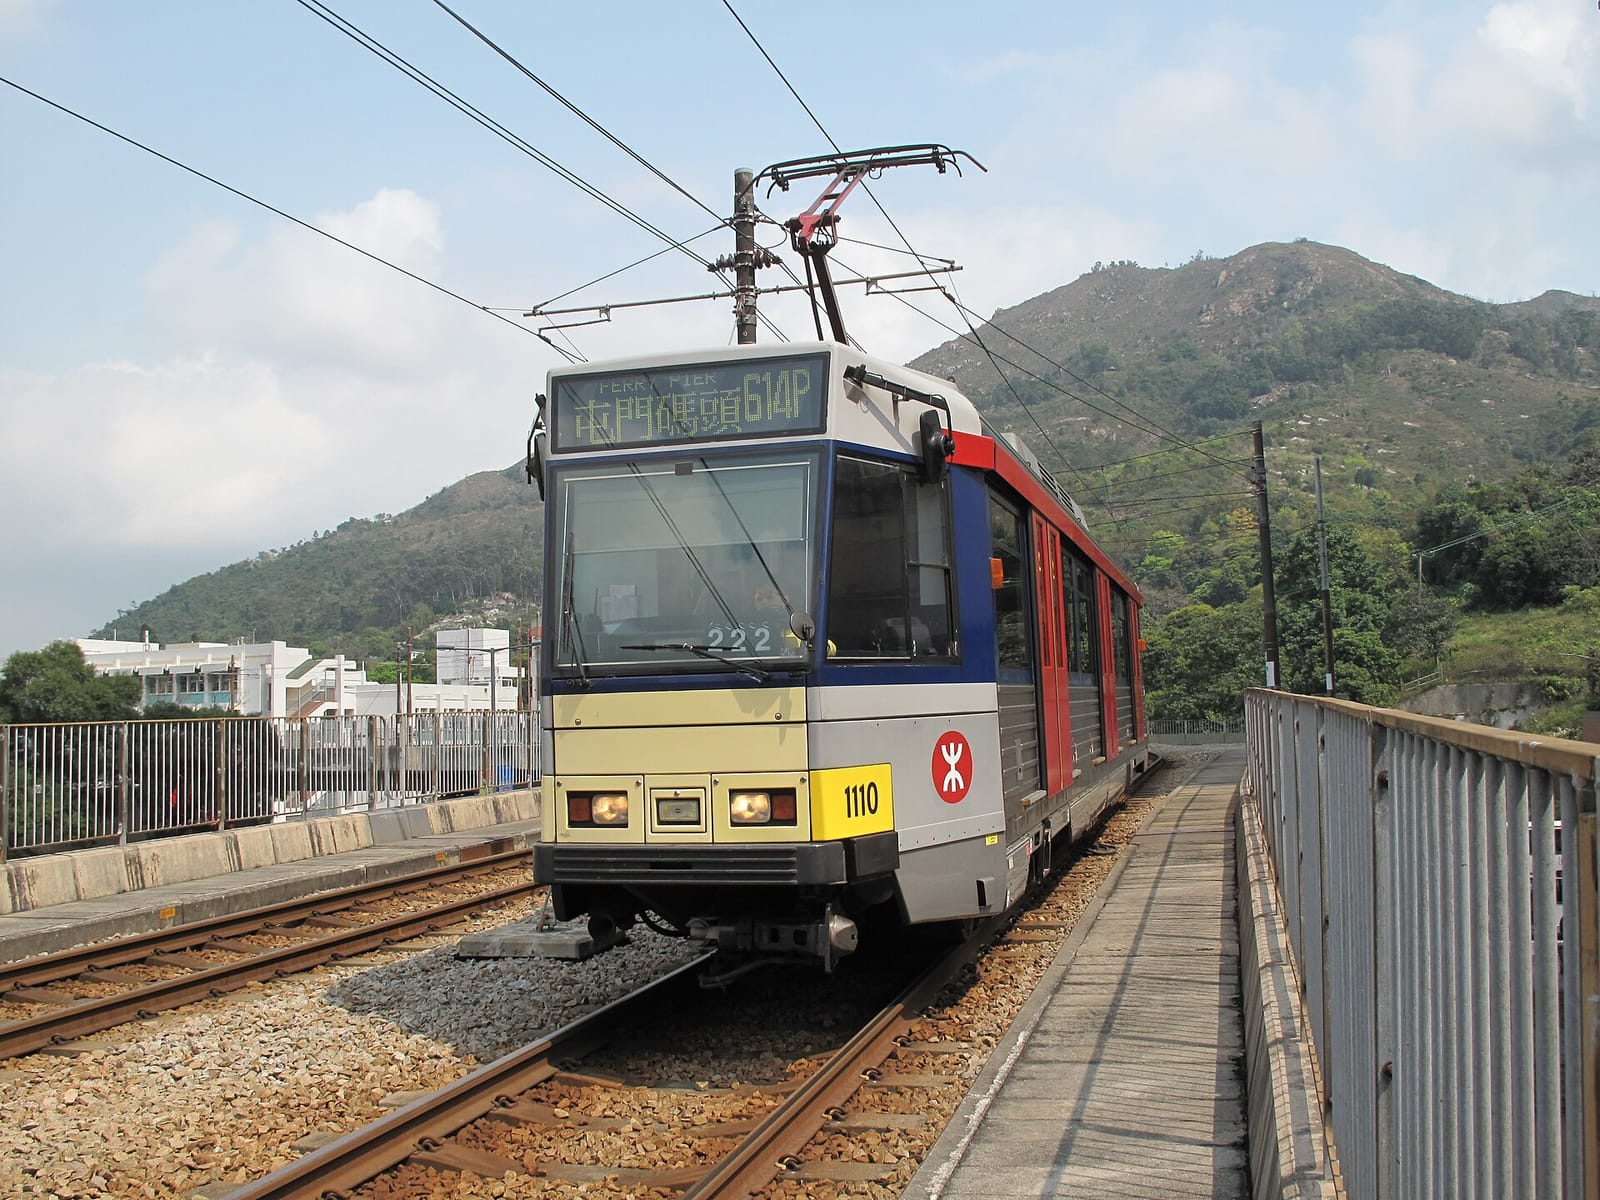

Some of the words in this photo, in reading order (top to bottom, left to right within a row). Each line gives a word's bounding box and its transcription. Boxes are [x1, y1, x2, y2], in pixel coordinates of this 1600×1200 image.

[668, 373, 717, 388] PIER
[743, 368, 811, 422] 614P
[575, 386, 743, 445] 屯門碼頭
[707, 627, 771, 652] 222
[844, 781, 879, 818] 1110
